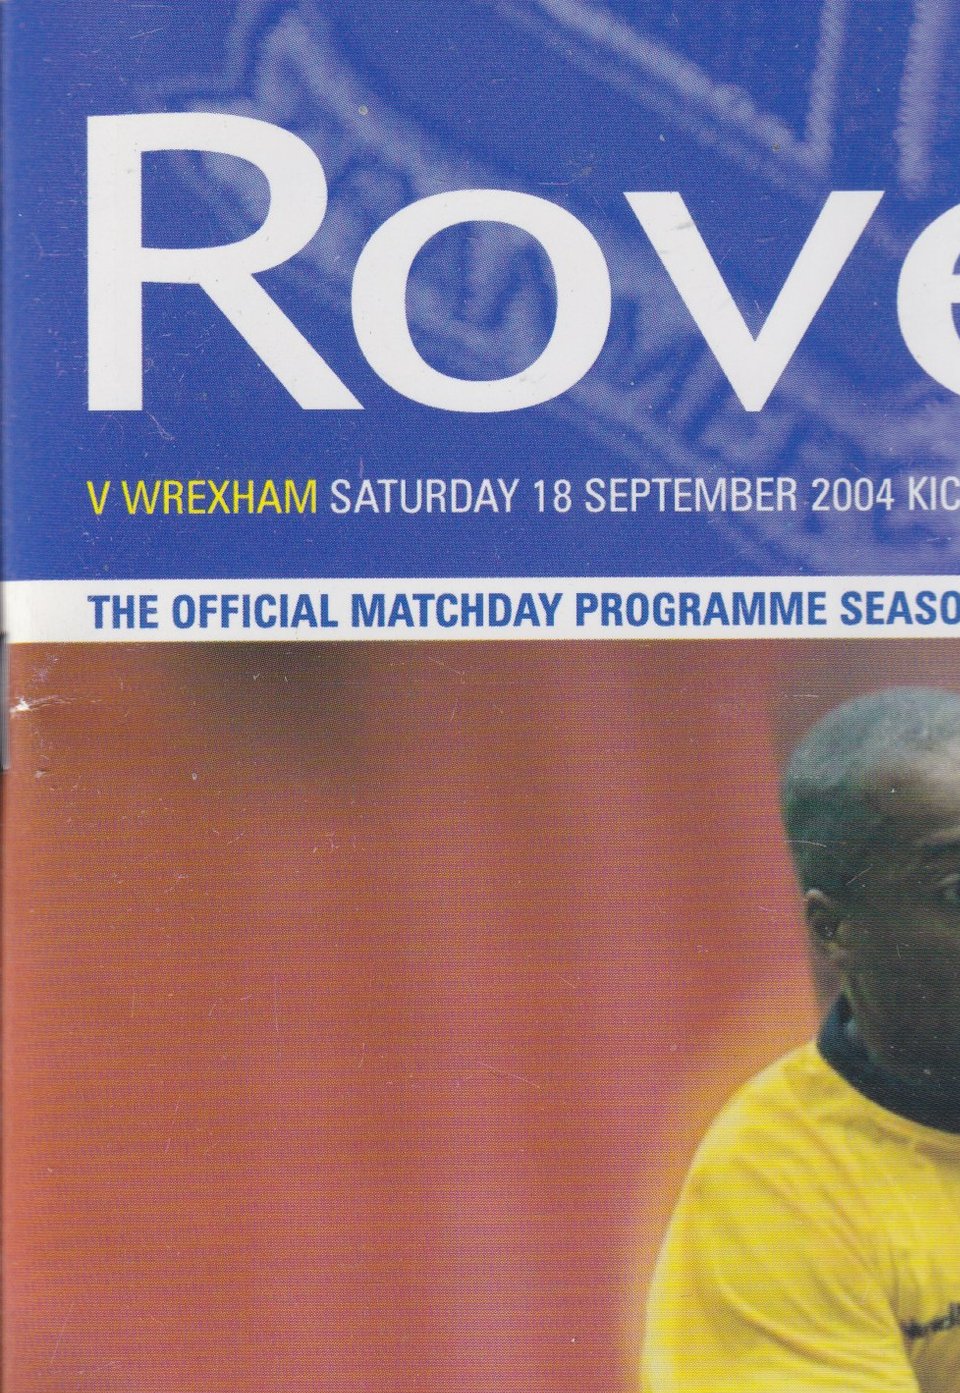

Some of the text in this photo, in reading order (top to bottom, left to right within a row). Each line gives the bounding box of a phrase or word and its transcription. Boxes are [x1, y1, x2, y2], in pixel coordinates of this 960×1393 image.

[87, 480, 111, 515] V
[122, 479, 318, 515] WREXHAM
[331, 478, 520, 514] SATURDAY
[533, 478, 573, 513] 18
[585, 477, 798, 513] SEPTEMBER
[811, 477, 896, 512] 2004
[87, 594, 159, 629] THE
[172, 593, 339, 629] OFFICIAL
[350, 593, 563, 628] MATCHDAY
[576, 592, 827, 627] PROGRAMME
